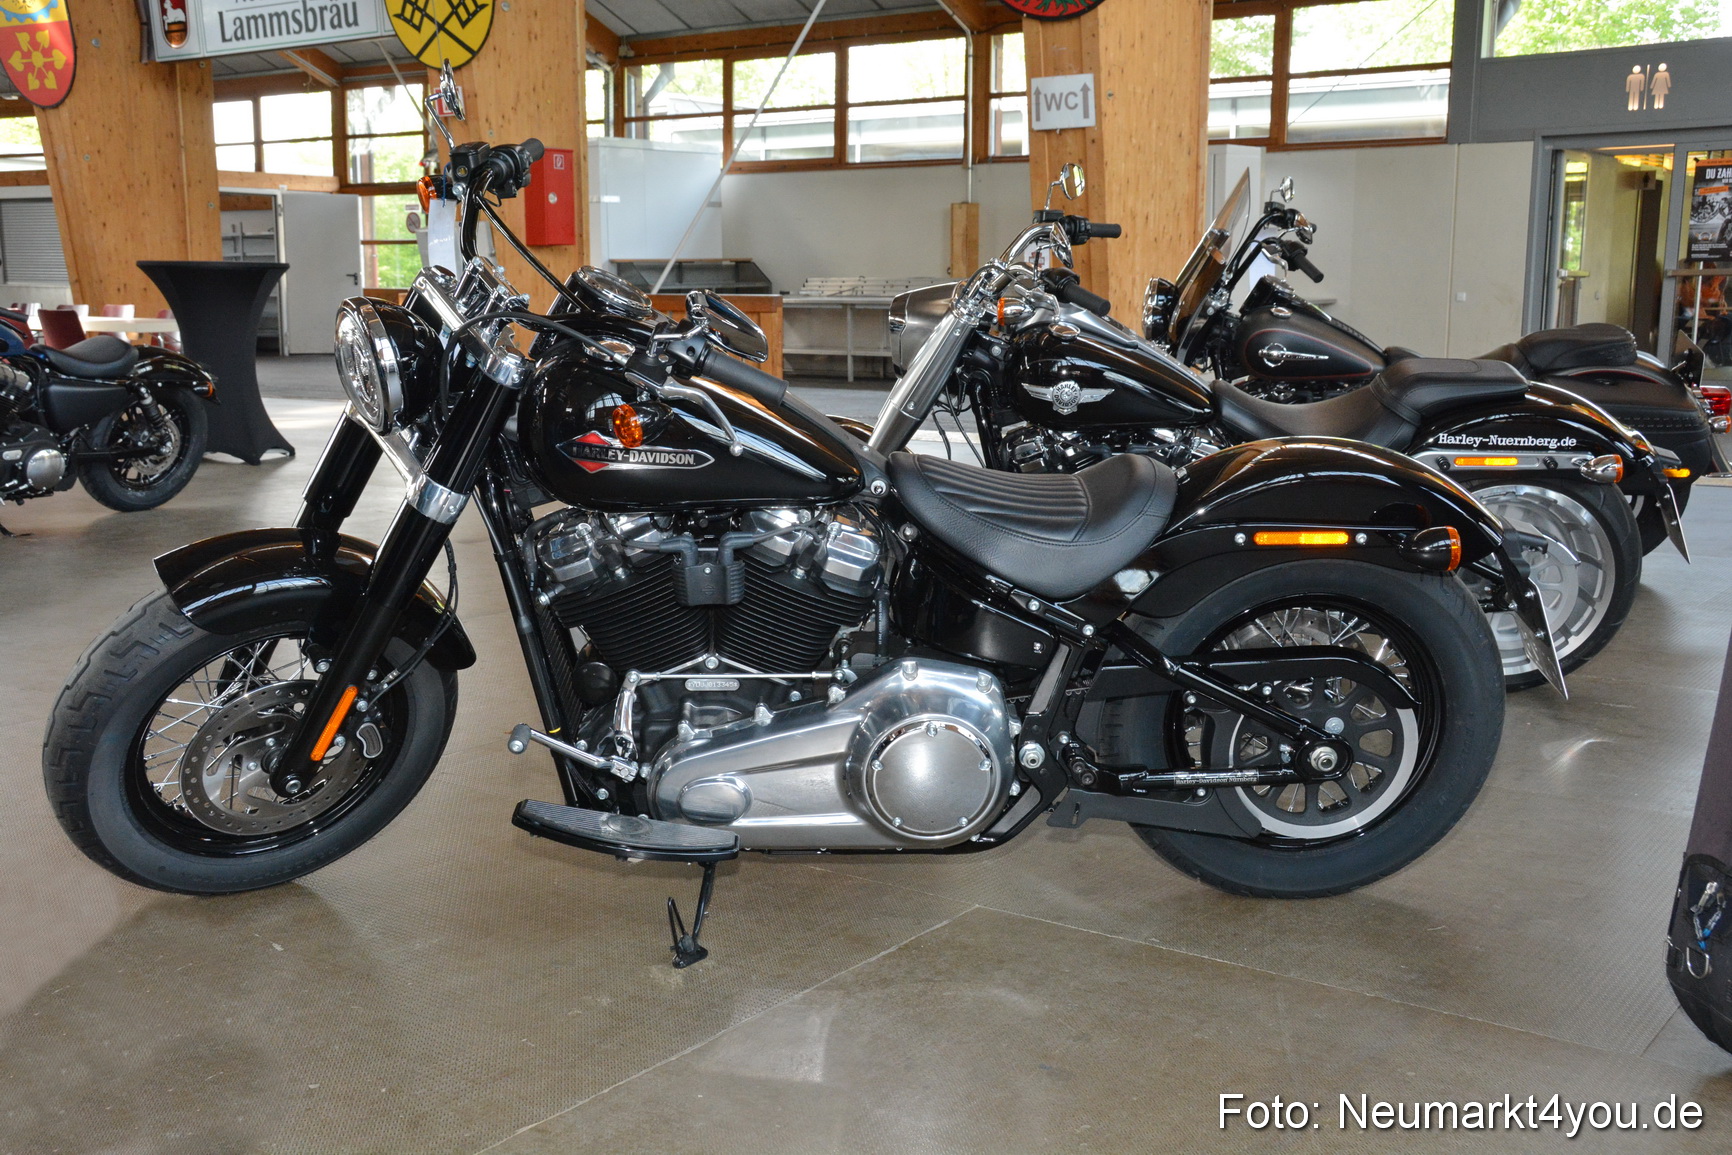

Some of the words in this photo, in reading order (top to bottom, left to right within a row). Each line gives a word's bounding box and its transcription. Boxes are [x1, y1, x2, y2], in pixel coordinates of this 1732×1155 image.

[218, 0, 360, 43] Lammsbräu
[1043, 91, 1079, 112] WC
[1705, 168, 1716, 180] DU
[1438, 432, 1577, 449] Harley-Nuernberg.de
